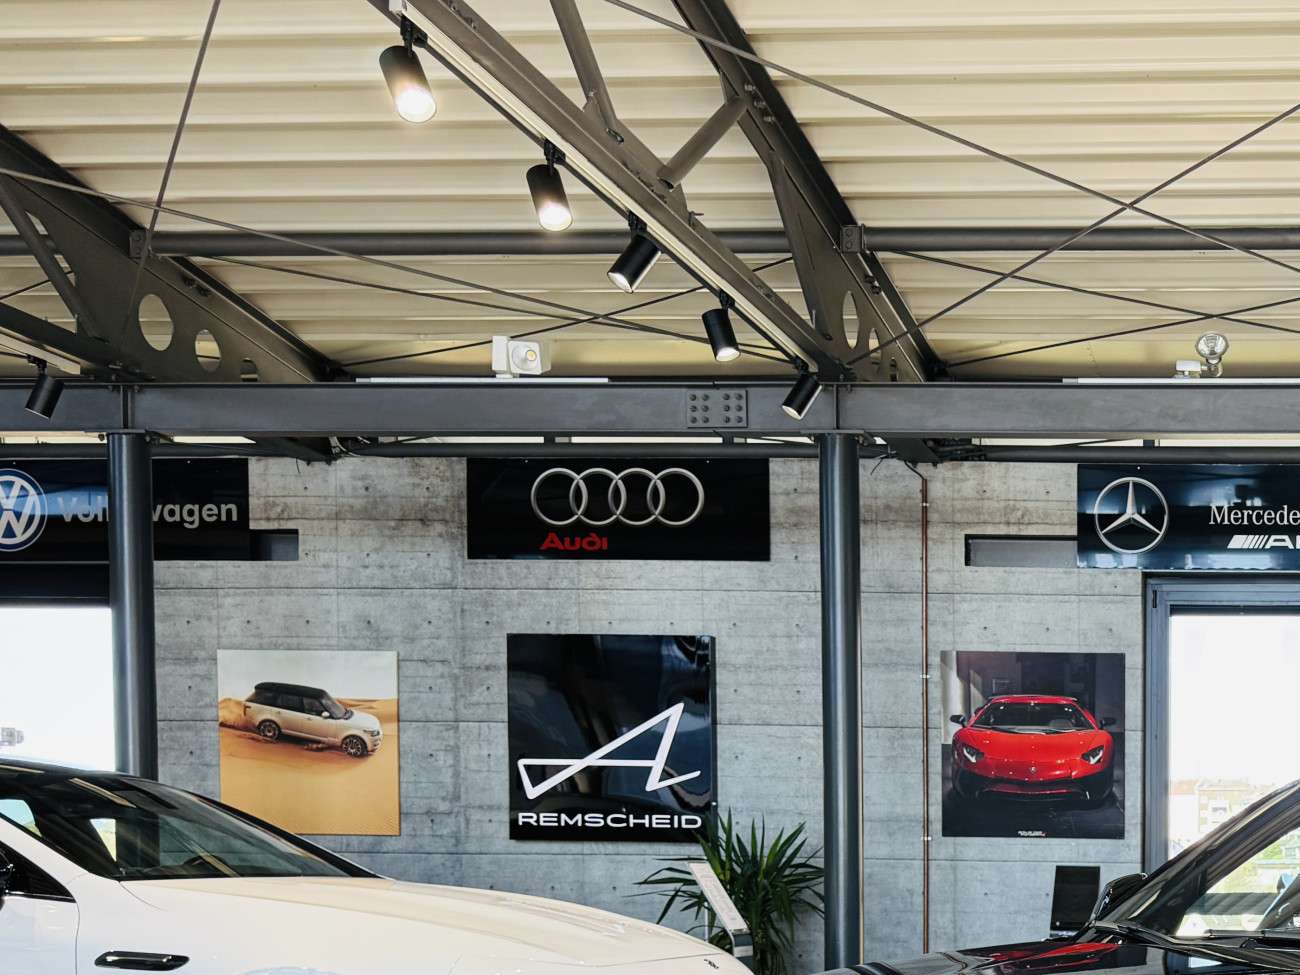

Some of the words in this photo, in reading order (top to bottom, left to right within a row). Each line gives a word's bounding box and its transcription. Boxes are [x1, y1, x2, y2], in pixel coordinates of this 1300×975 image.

[57, 495, 239, 529] Volagen
[540, 532, 608, 550] Audi
[517, 812, 702, 829] REMSCHEID
